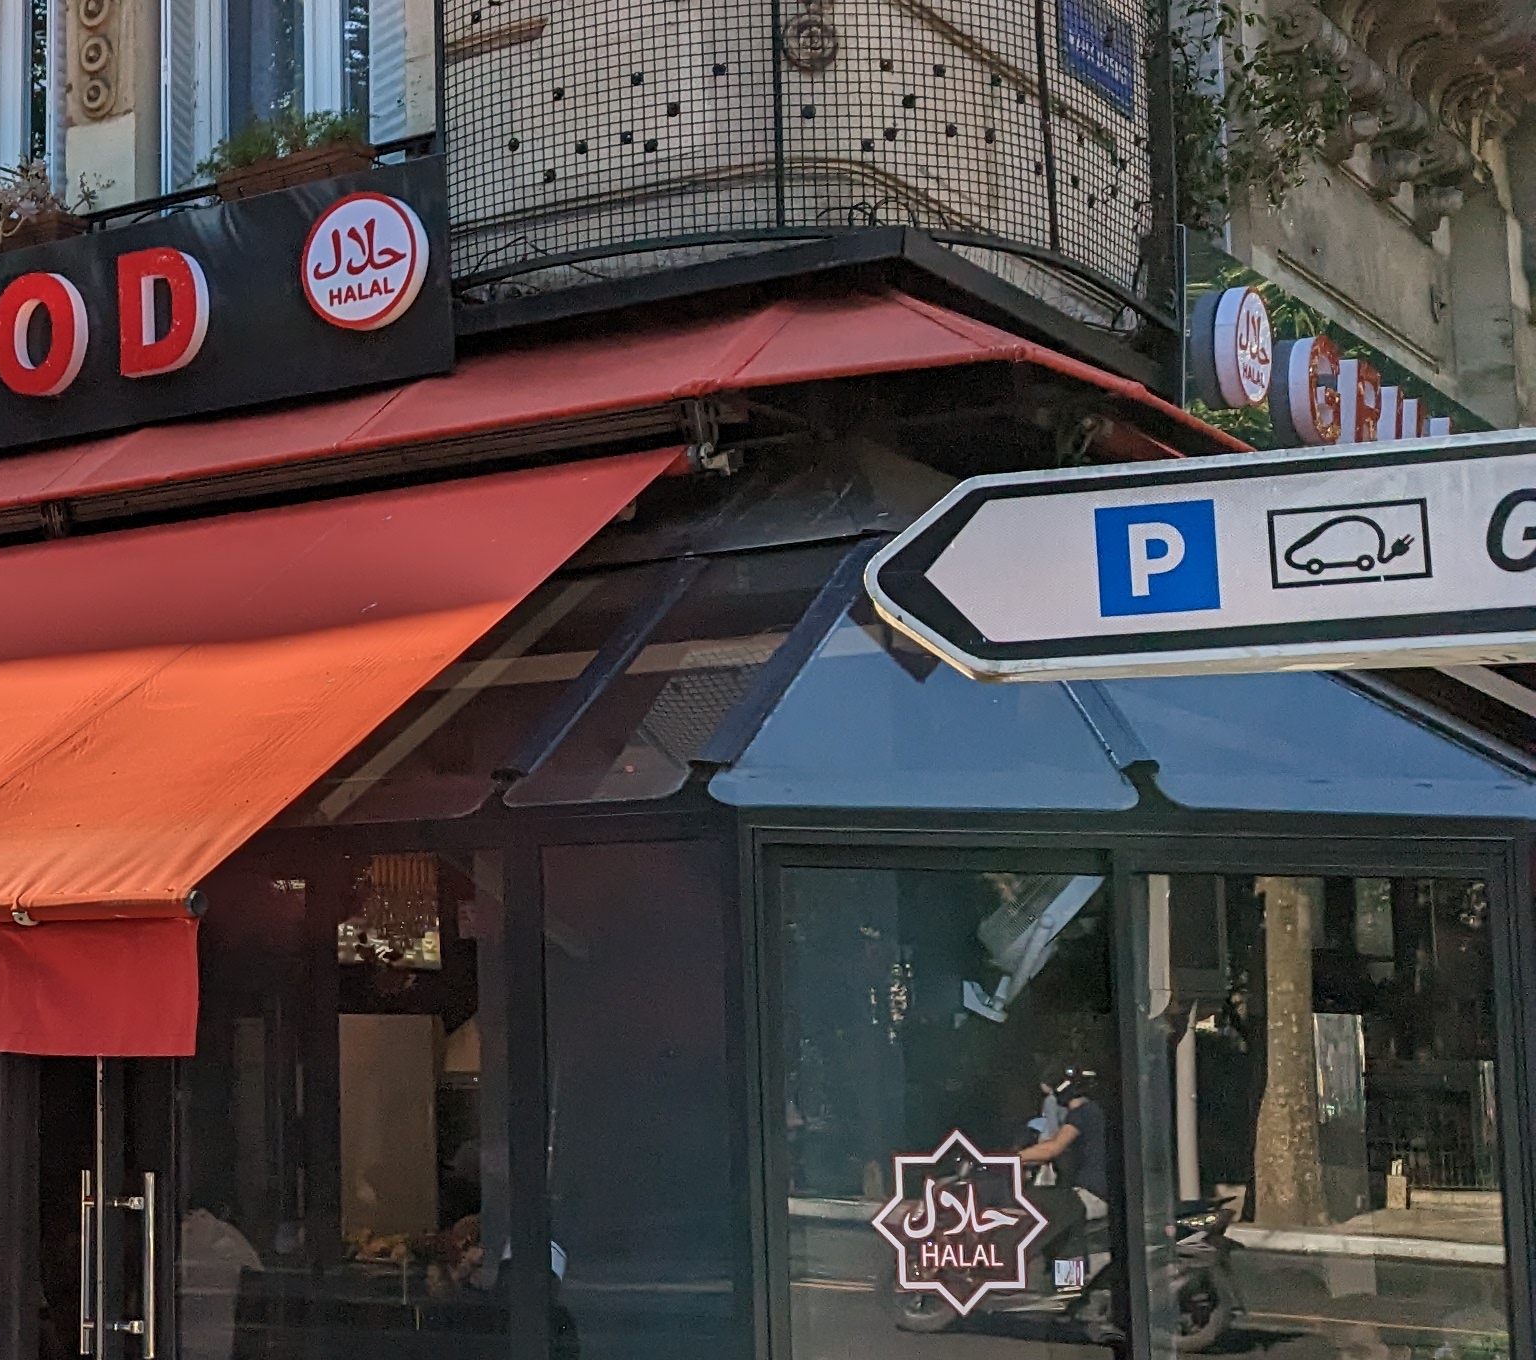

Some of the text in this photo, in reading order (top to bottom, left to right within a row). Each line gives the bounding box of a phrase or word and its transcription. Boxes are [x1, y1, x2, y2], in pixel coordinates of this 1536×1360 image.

[313, 218, 407, 281] حلال
[328, 276, 396, 307] HALAL
[1239, 309, 1270, 366] حلال
[1243, 361, 1265, 389] HALAL
[1126, 522, 1186, 597] P
[903, 1178, 1019, 1239] حلال
[921, 1243, 1004, 1268] HALAL
